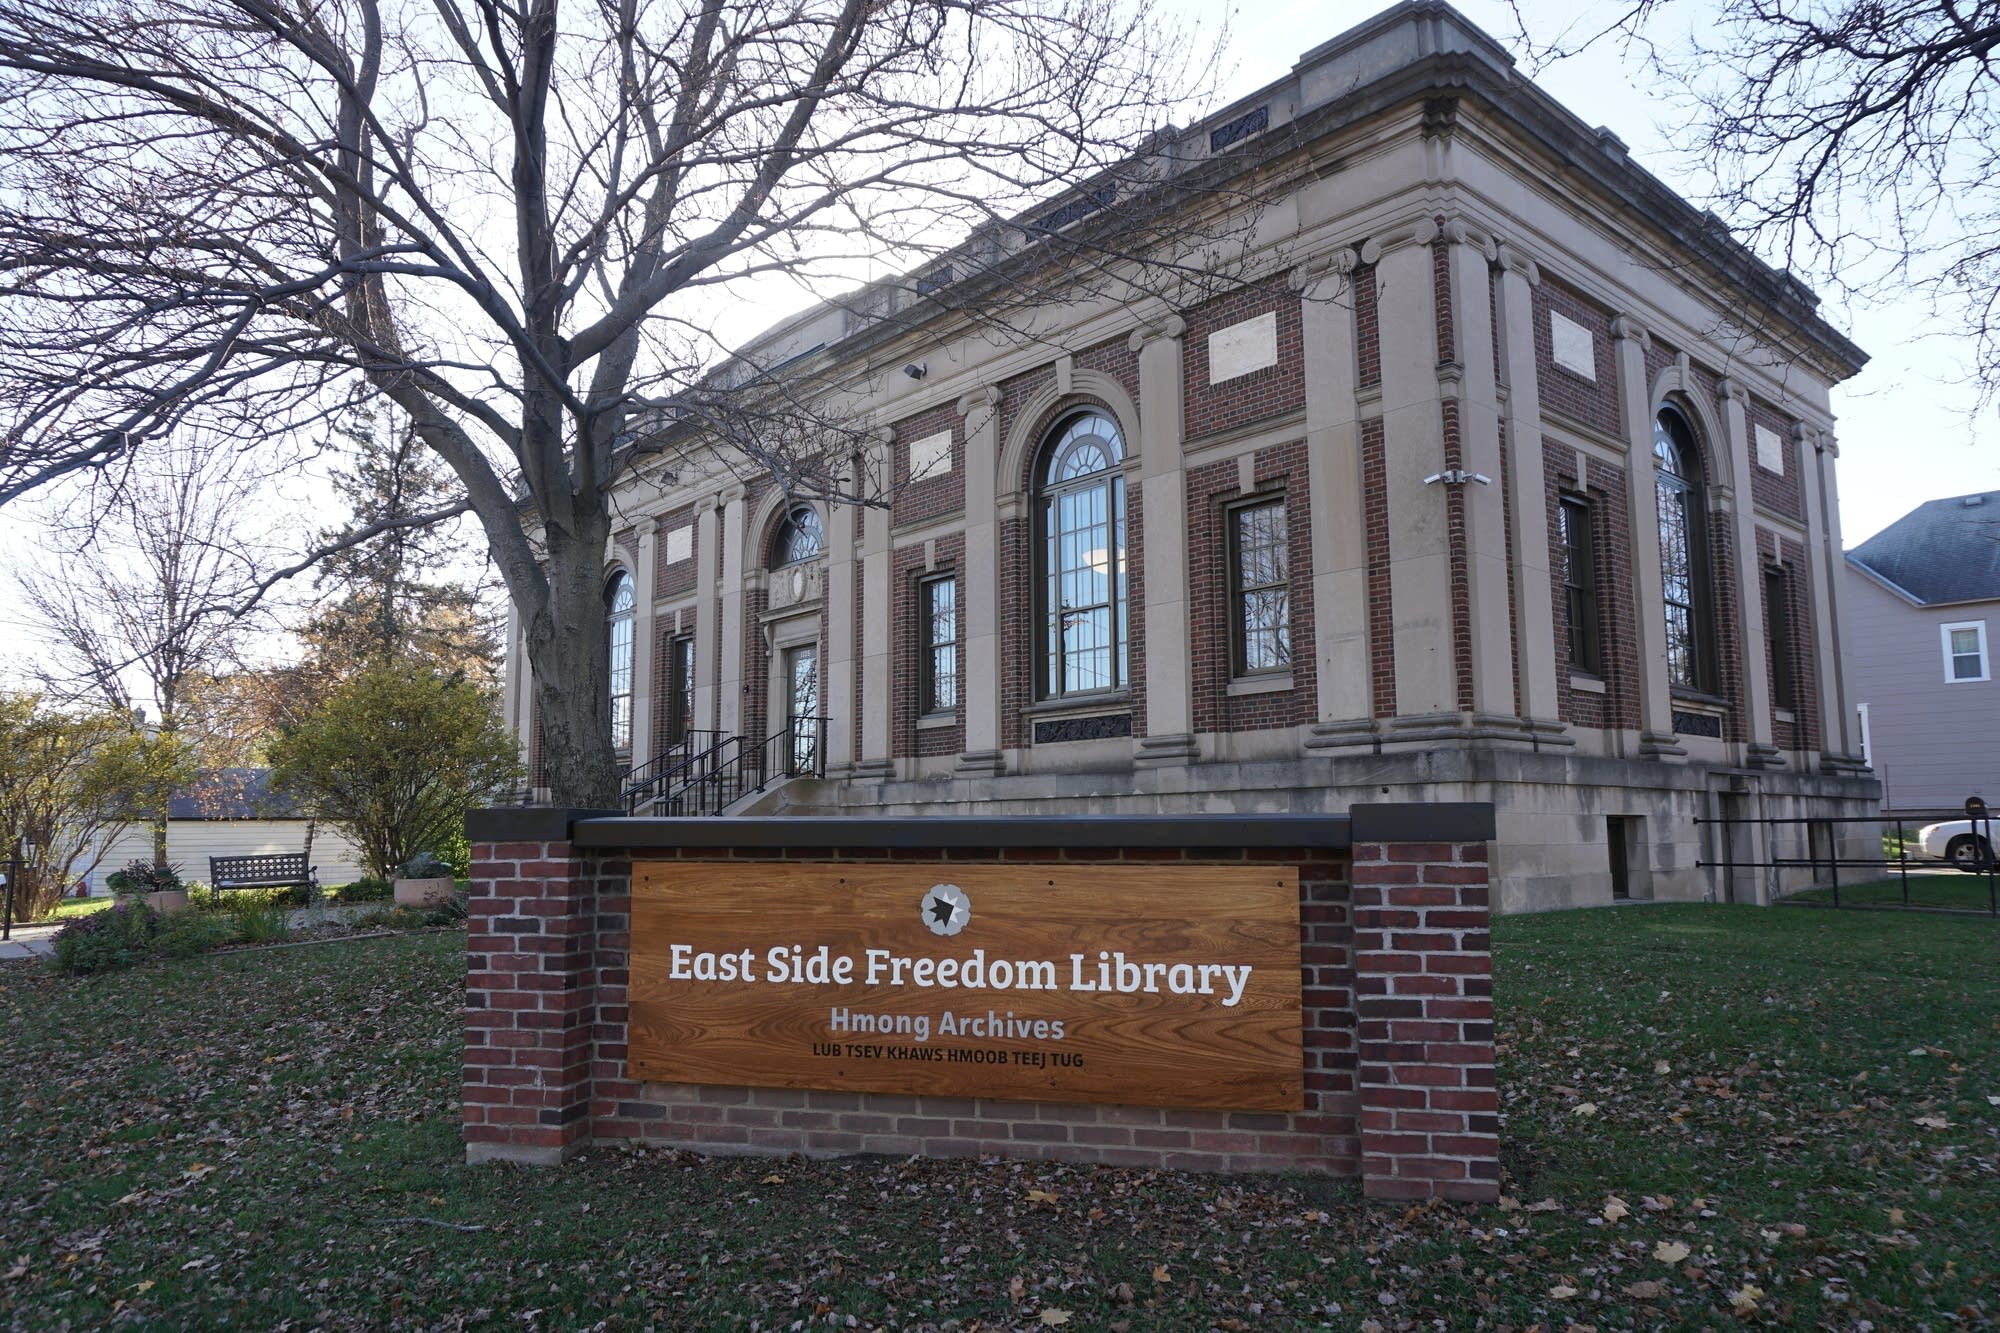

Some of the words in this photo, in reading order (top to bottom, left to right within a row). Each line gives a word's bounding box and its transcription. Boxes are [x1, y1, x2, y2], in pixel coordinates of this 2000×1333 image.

[669, 944, 756, 982] East
[767, 944, 853, 985] Side
[865, 949, 1058, 990] Freedom
[1069, 950, 1252, 1007] Library
[830, 1007, 930, 1042] Hmong
[938, 1010, 1065, 1040] Archives
[813, 1043, 841, 1057] LUB
[846, 1045, 883, 1059] TSEV
[887, 1046, 943, 1062] KHAWS
[948, 1048, 1008, 1064] HMOOB
[1012, 1051, 1047, 1070] TEEJ
[1051, 1053, 1084, 1067] TUG
